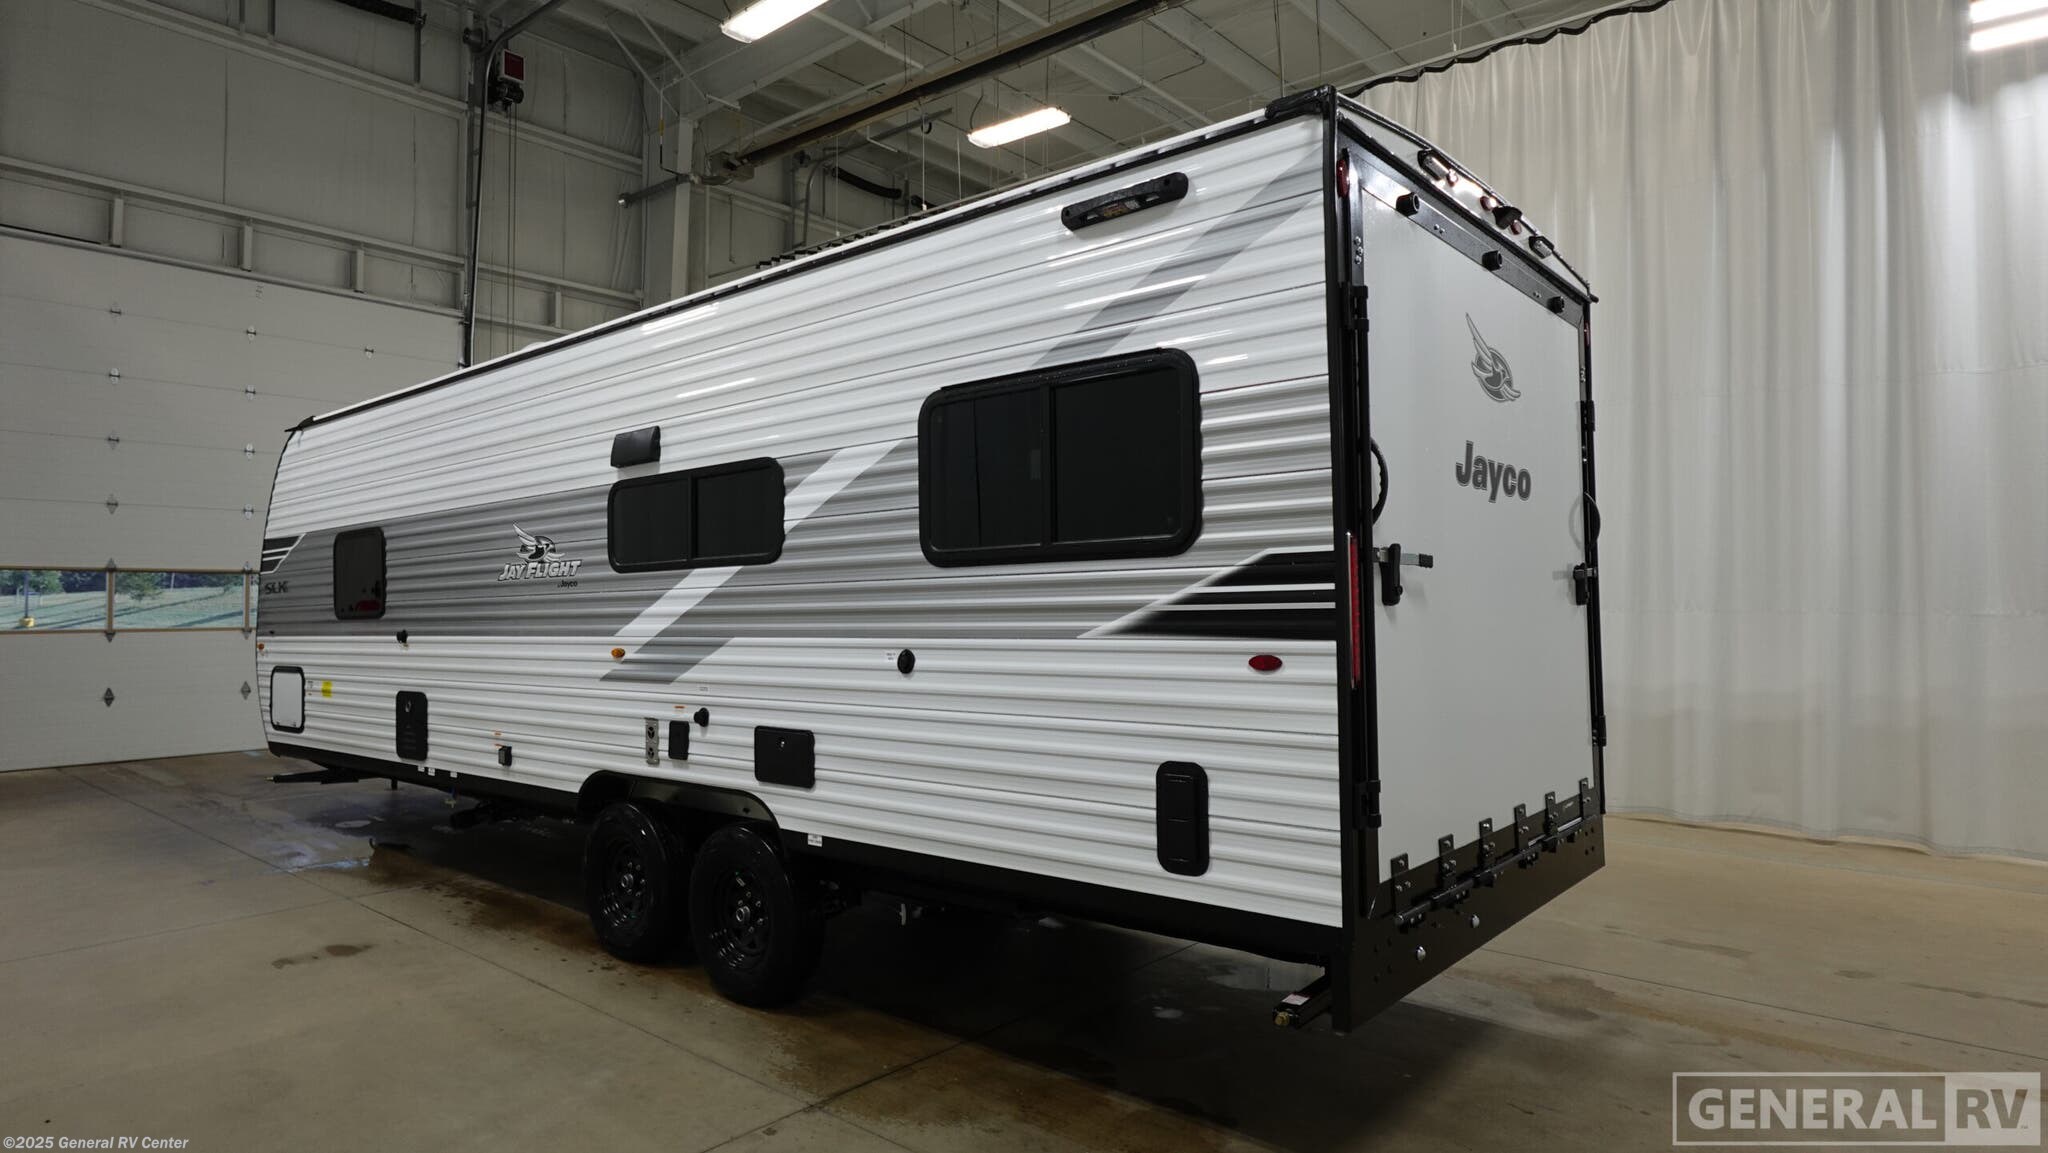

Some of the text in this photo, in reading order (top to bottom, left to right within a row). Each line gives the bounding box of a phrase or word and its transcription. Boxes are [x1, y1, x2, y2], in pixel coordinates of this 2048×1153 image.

[1455, 440, 1532, 503] Jayco
[498, 559, 582, 581] JAY FLIGHT
[265, 581, 289, 595] SLK
